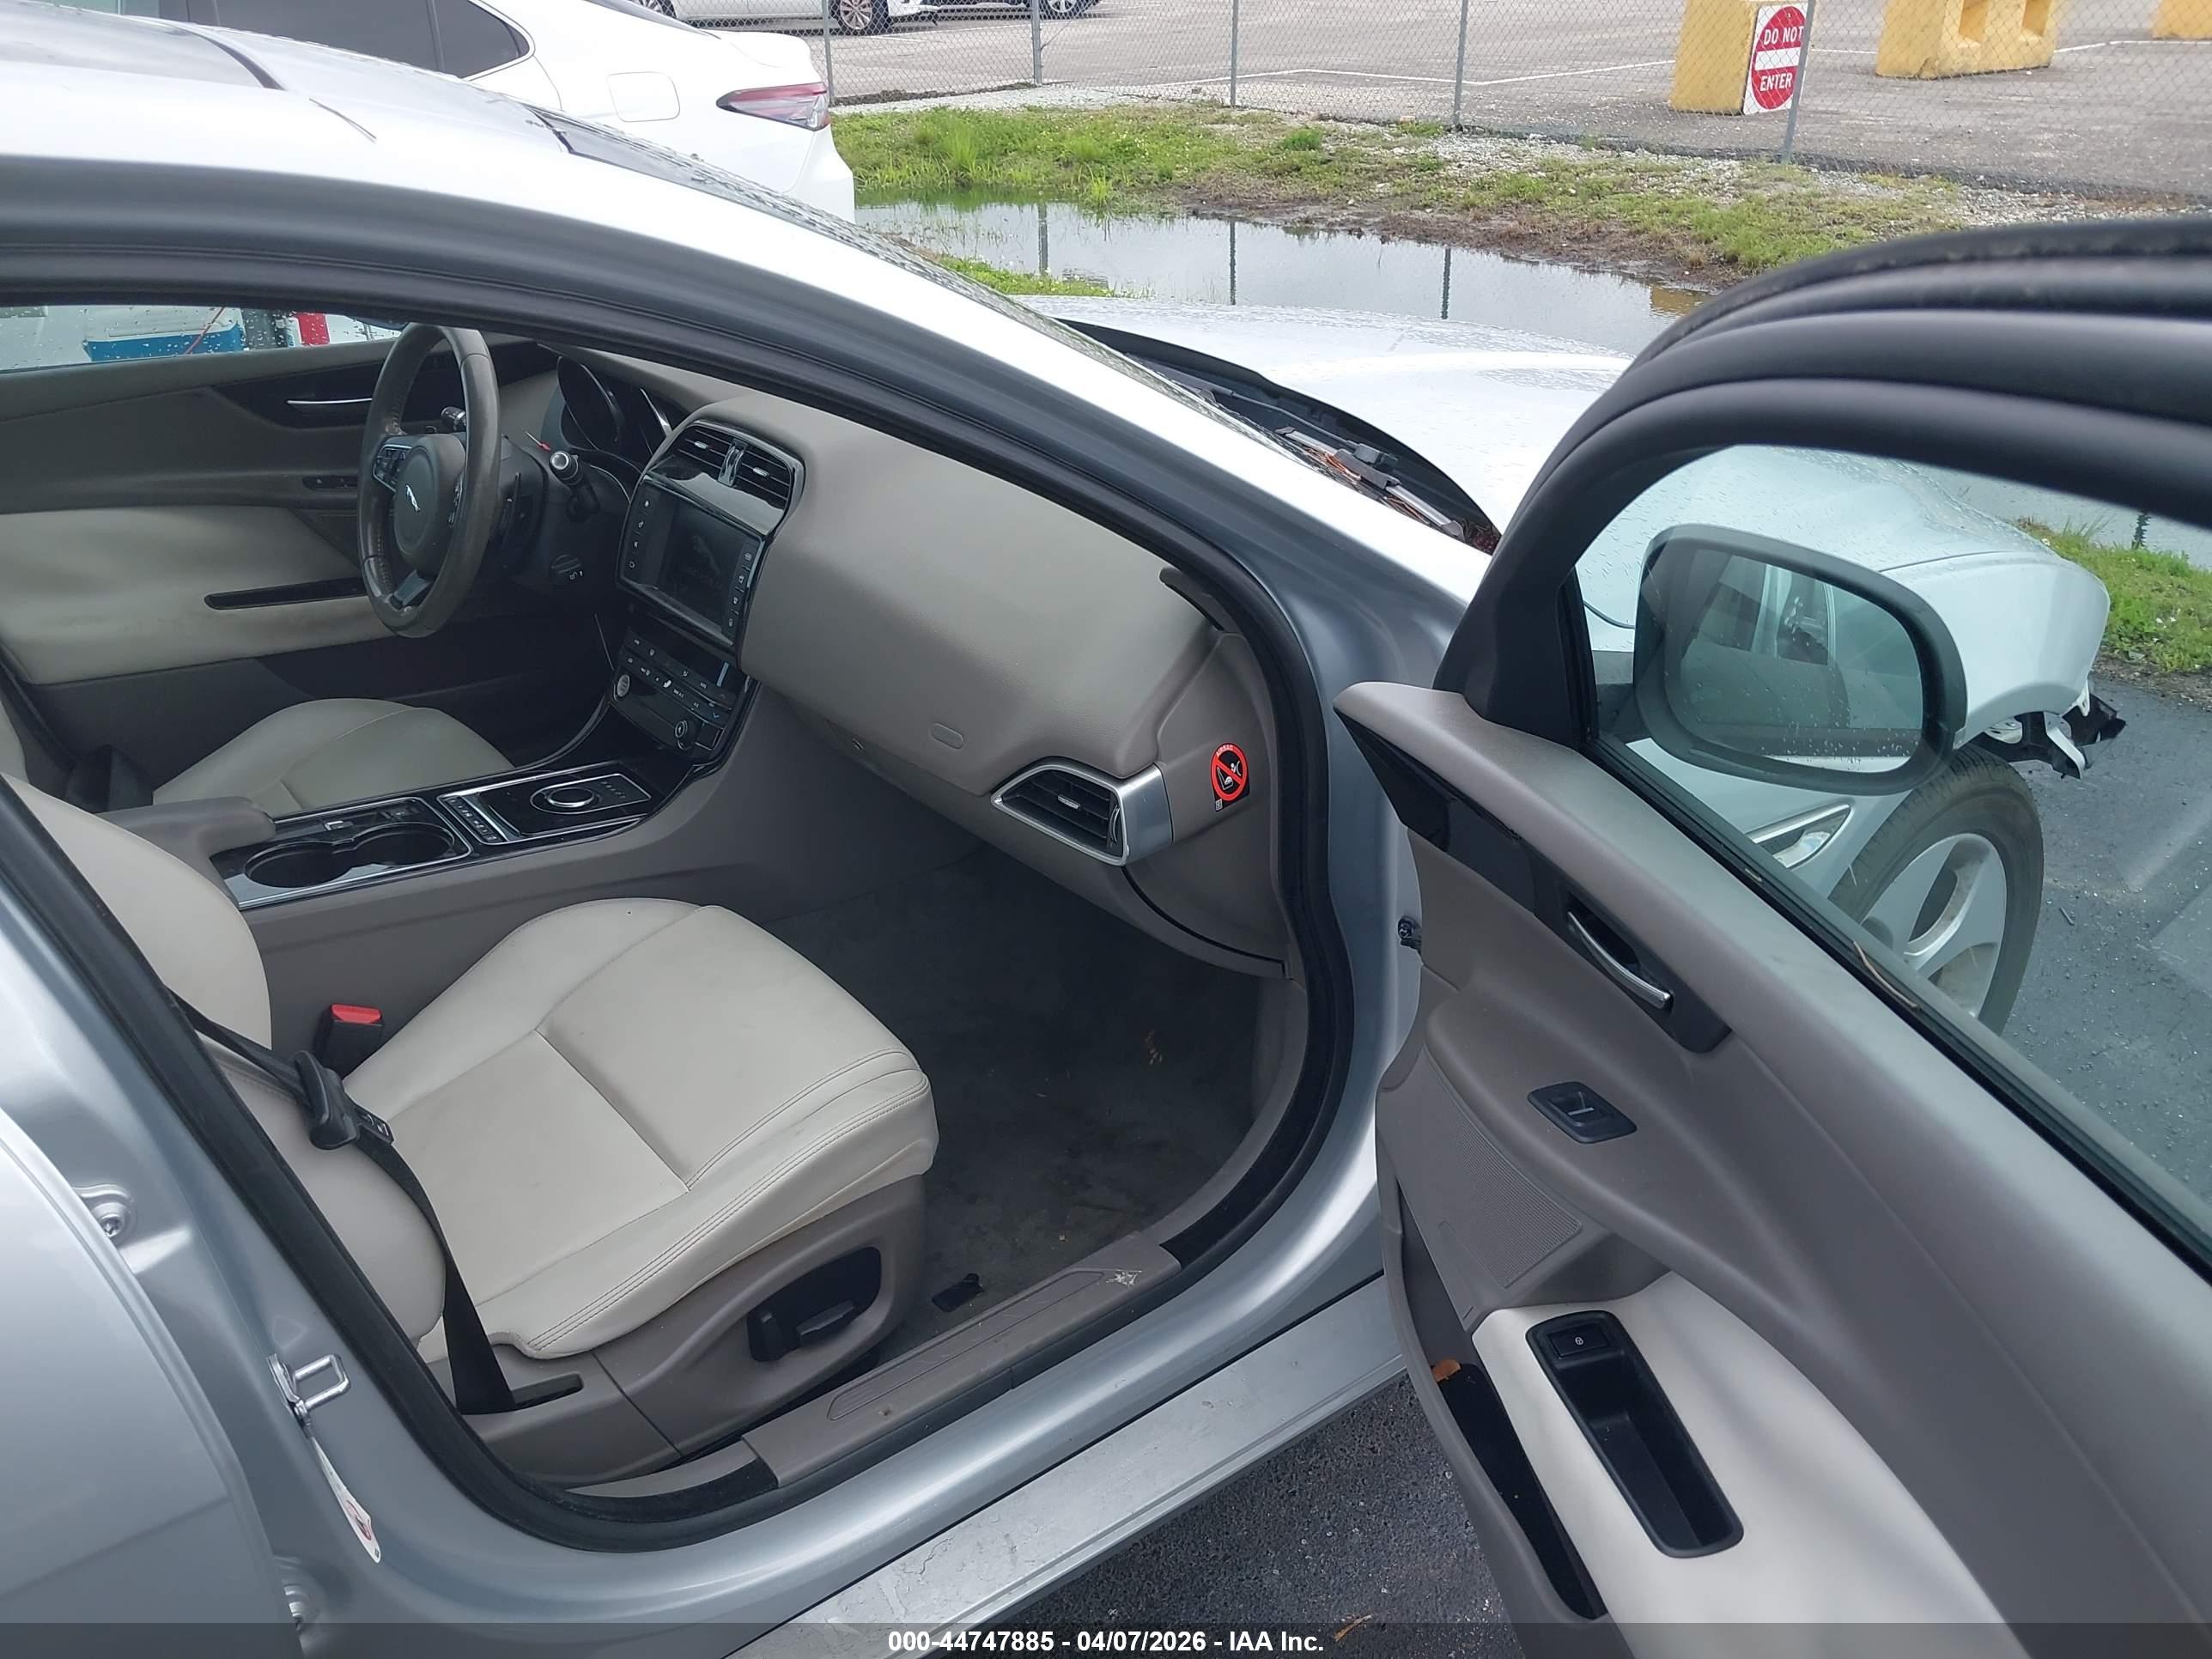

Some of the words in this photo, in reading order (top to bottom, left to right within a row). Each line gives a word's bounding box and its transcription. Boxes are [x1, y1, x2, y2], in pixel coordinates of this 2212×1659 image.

[1764, 27, 1779, 45] DO
[1783, 26, 1805, 43] NOT
[1760, 72, 1793, 92] ENTER
